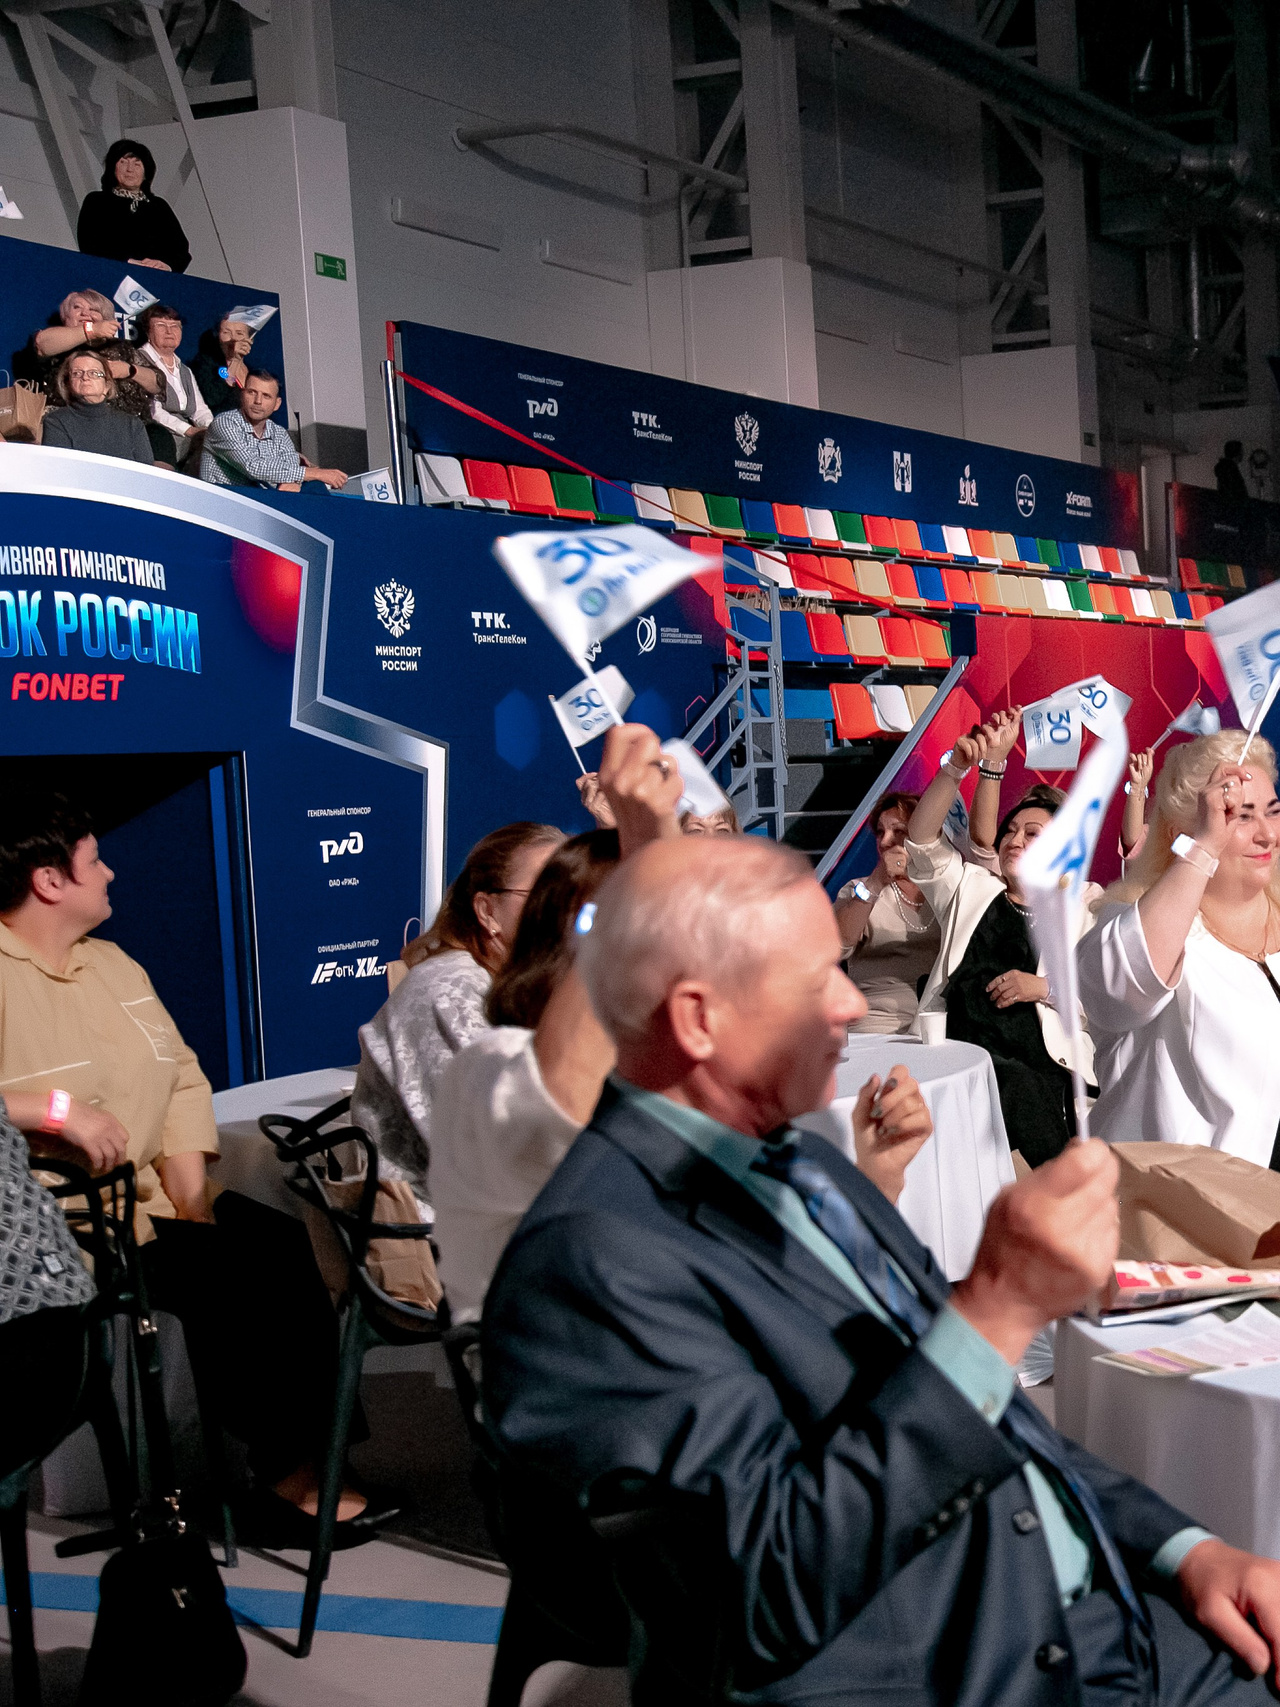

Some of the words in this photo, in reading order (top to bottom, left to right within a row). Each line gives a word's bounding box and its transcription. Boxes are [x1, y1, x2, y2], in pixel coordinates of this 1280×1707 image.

[633, 428, 673, 443] ТрансТелеКом
[734, 459, 763, 472] МИНСПОРТ
[738, 471, 761, 482] РОССИИ
[60, 547, 167, 591] ГИМНАСТИКА
[53, 590, 202, 675] РОССИИ
[473, 632, 527, 645] ТрансТелеКом
[375, 645, 422, 657] МИНСПОРТ
[382, 660, 418, 672] РОССИИ
[11, 672, 125, 701] FONBET
[1046, 708, 1072, 746] 30
[307, 807, 345, 818] ГЕНЕРАЛЬНЫЙ
[346, 806, 372, 816] СПОНСОР
[328, 878, 341, 888] ОАО
[317, 941, 357, 954] ОФИЦИАЛЬНЫЙ
[335, 964, 355, 978] ФГК
